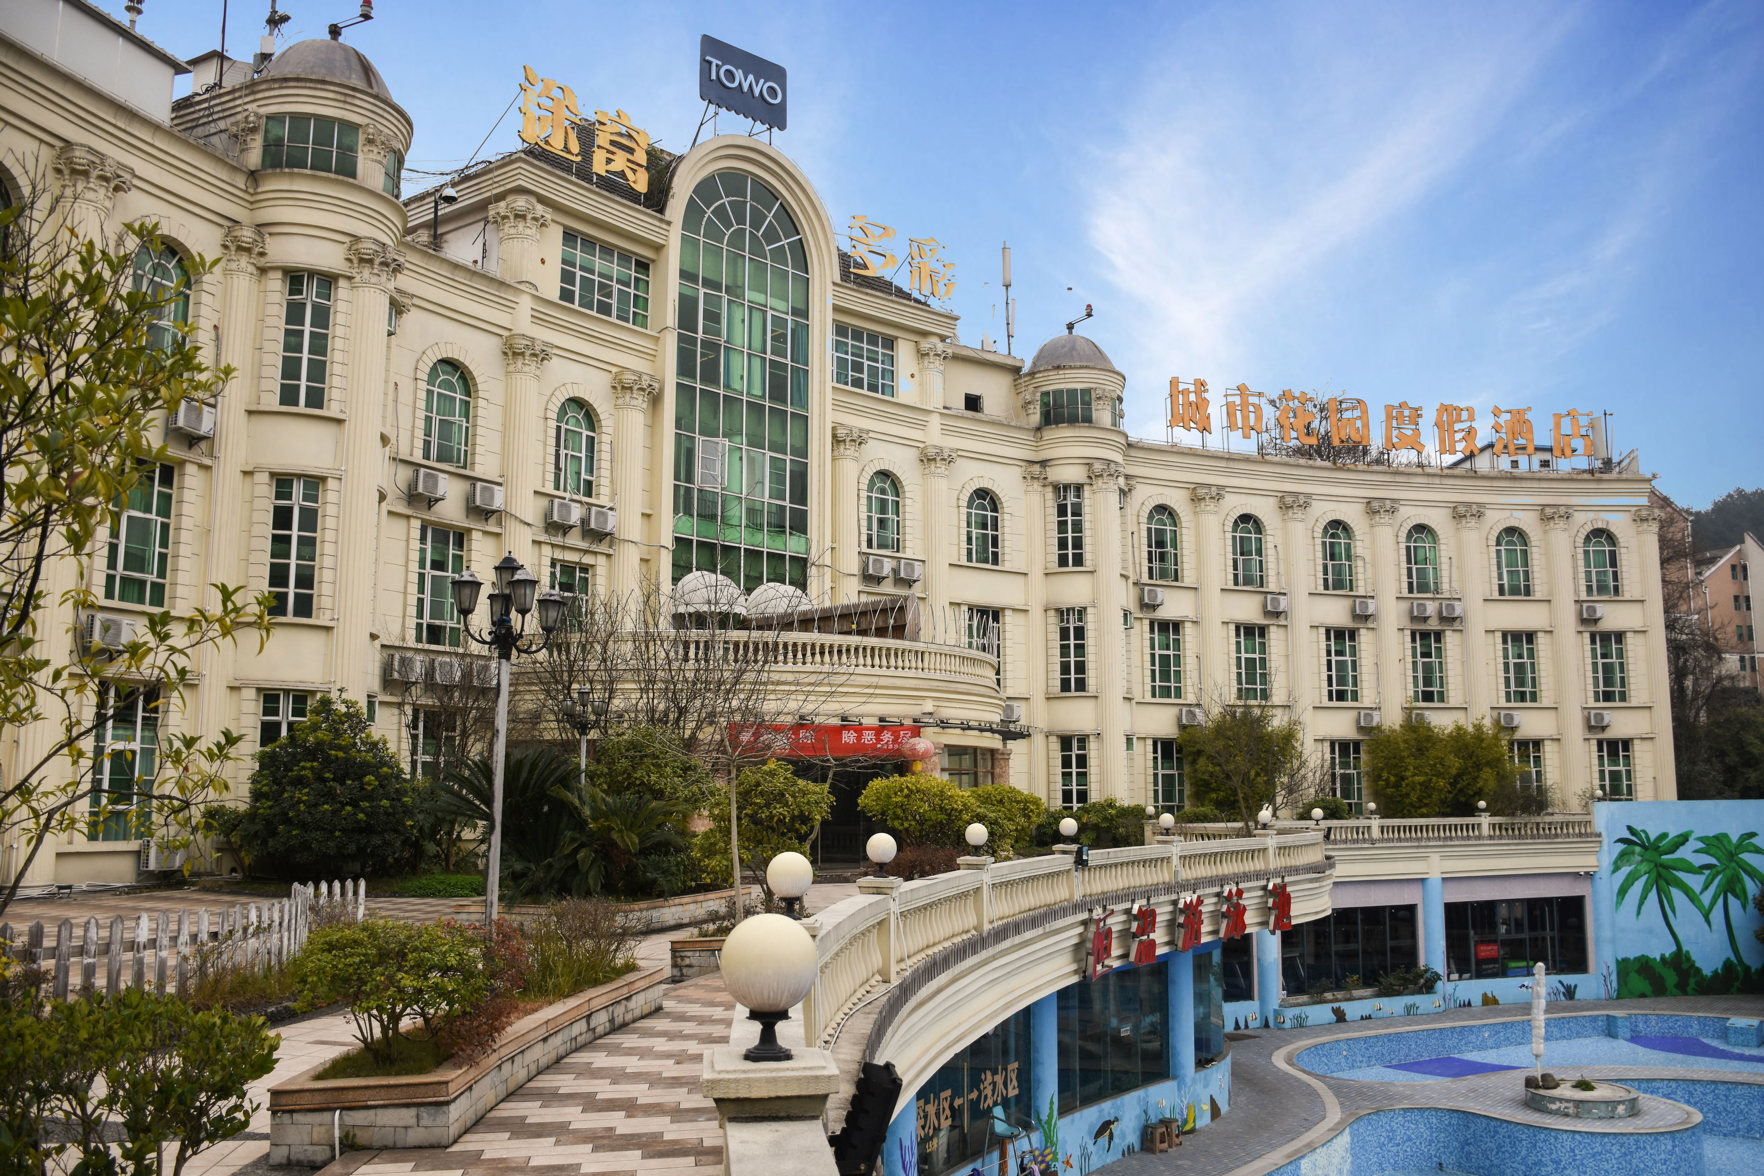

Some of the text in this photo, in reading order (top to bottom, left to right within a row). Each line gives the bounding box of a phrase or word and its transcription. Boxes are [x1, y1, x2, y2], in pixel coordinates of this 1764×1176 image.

[705, 56, 782, 105] TOWO
[518, 64, 650, 193] 途窝
[1169, 376, 1594, 459] 城市花园度假酒店
[842, 730, 912, 744] 除恶务尽
[979, 1061, 1020, 1111] 浅水区
